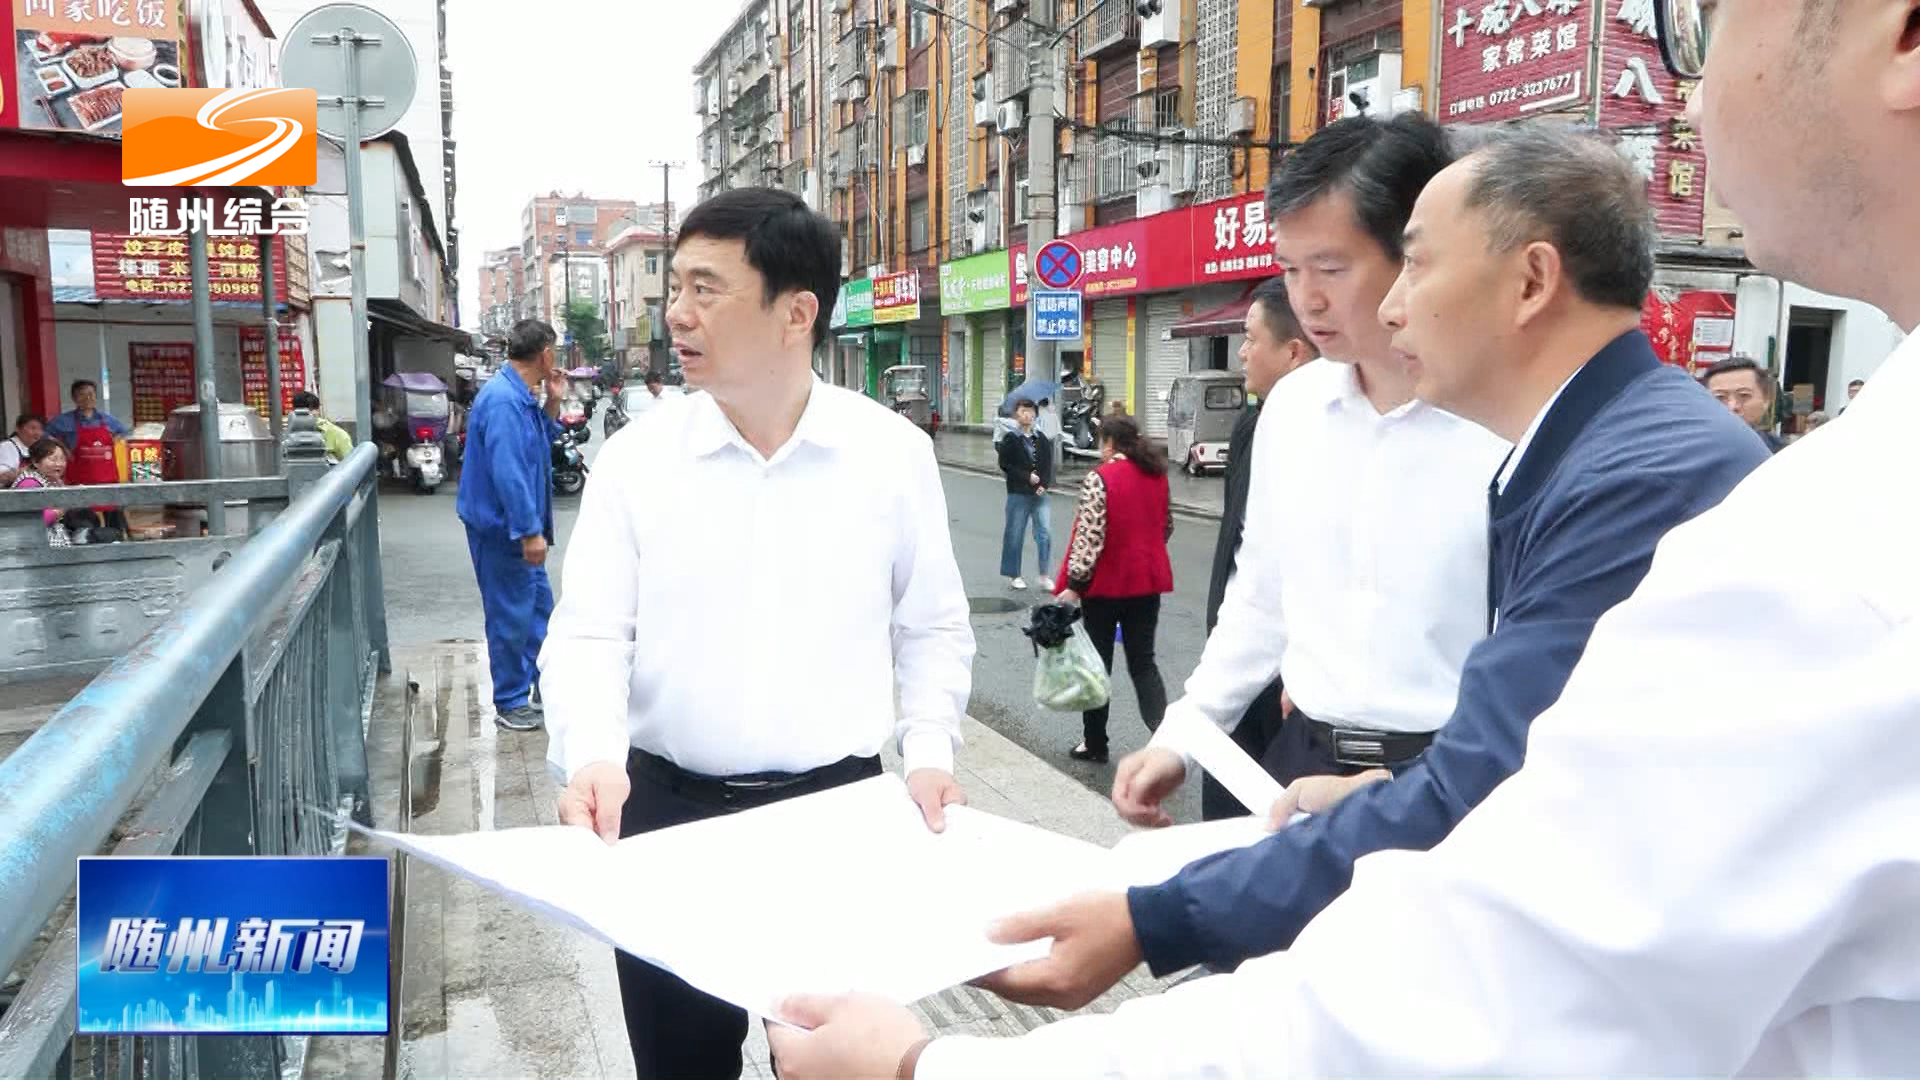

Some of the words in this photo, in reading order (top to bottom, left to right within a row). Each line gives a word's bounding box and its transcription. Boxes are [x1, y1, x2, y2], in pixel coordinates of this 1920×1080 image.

[1482, 22, 1579, 73] 家常菜馆
[1082, 241, 1137, 274] 美容中心
